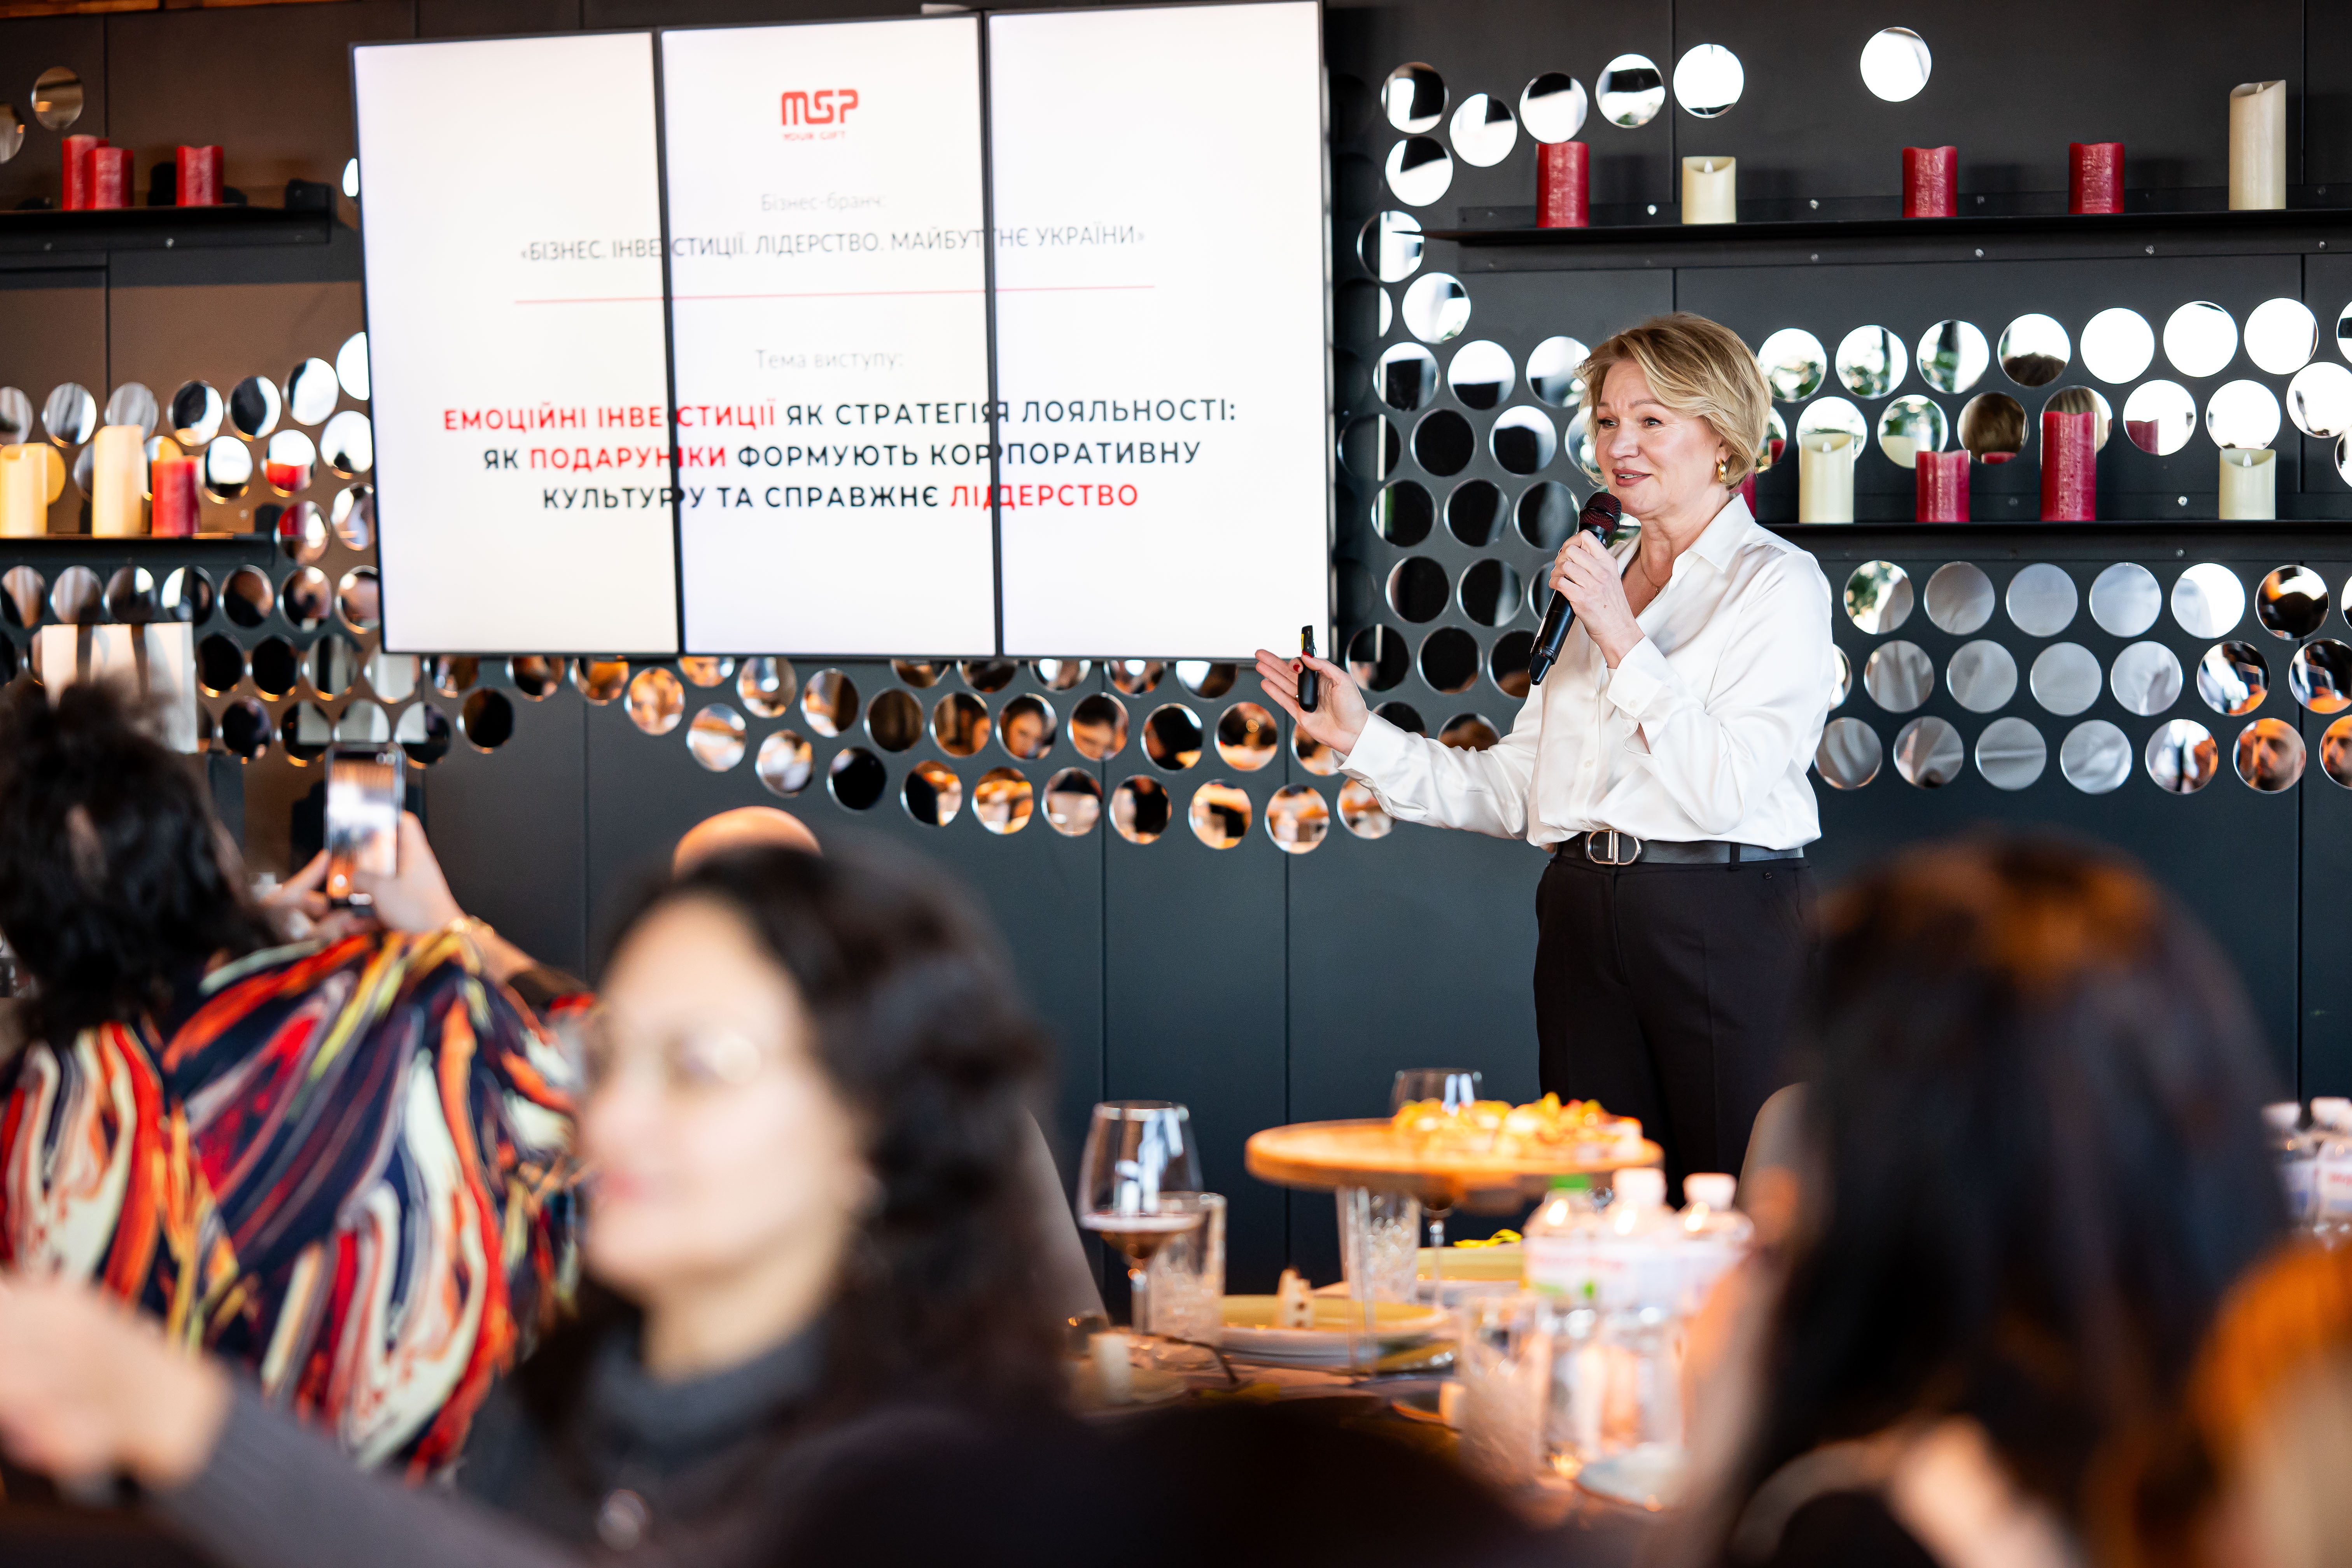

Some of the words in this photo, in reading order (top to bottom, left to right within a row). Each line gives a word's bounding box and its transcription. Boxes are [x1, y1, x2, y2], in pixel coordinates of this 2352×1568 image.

[781, 89, 859, 126] MSP
[755, 232, 883, 257] ЛІДЕРСТВО.
[891, 226, 1028, 250] МАЙБУТНЄ
[756, 349, 806, 368] Тема
[444, 403, 586, 433] ЕМОЦІЙНІ
[598, 399, 774, 430] ІНВЕСТИЦІЇ
[787, 405, 823, 425] ЯК
[836, 401, 1009, 425] СТРАТЕГІЯ
[1022, 399, 1235, 423] ЛОЯЛЬНОСТІ:
[484, 449, 518, 469] ЯК
[530, 446, 726, 472] ПОДАРУНКИ
[738, 444, 918, 468] ФОРМУЮТЬ
[931, 441, 1200, 466] КОРПОРАТИВНУ
[543, 487, 705, 509] КУЛЬТУРУ
[716, 487, 753, 508] ТА
[765, 485, 938, 508] СПРАВЖНЄ
[950, 484, 1138, 511] ЛІДЕРСТВО
